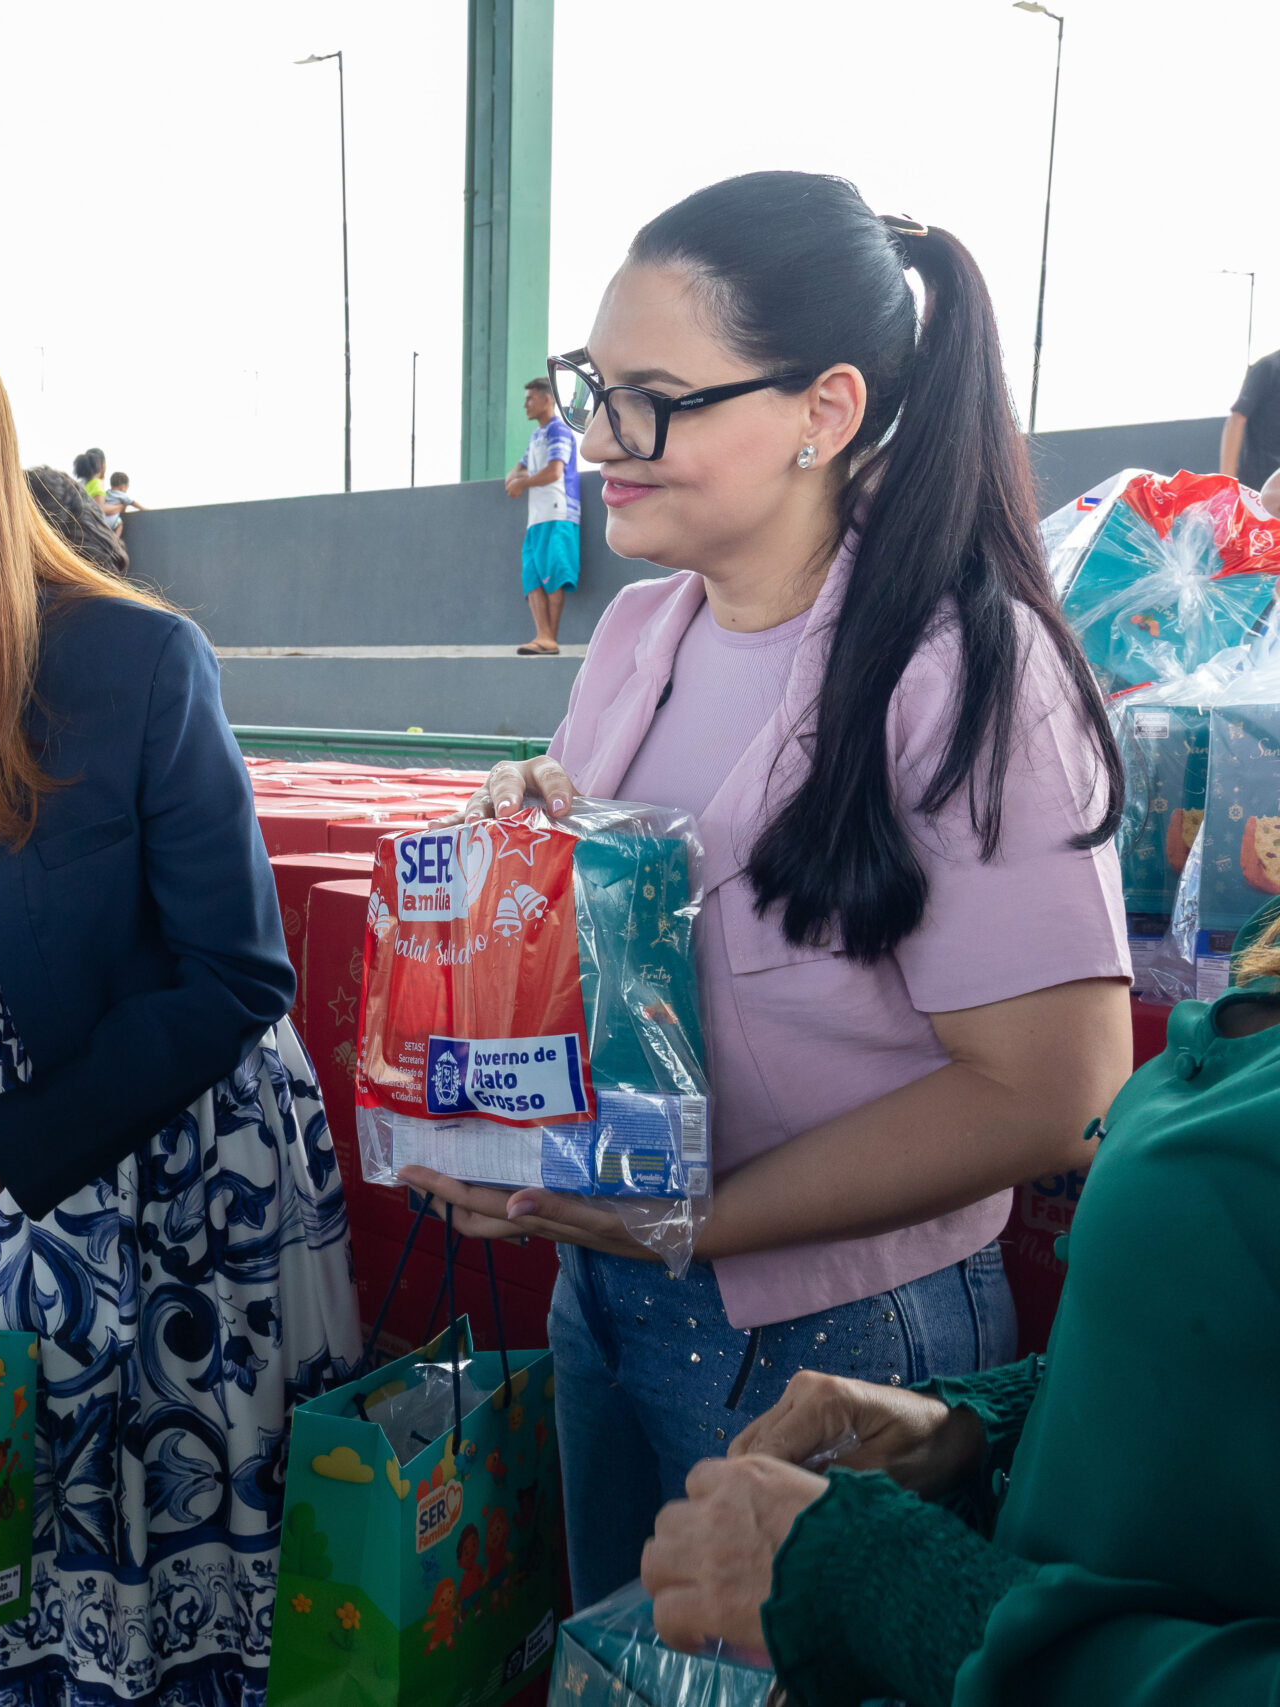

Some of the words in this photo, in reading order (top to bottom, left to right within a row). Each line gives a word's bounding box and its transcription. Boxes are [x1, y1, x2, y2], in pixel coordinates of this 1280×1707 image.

[400, 836, 453, 884] SER
[640, 963, 672, 985] Frutas
[404, 1041, 425, 1052] SETASC
[534, 1047, 557, 1063] de
[398, 1053, 424, 1065] Secretaria
[471, 1068, 518, 1090] Mato
[395, 1091, 423, 1104] Cidadania
[474, 1090, 546, 1112] Grosso
[419, 1499, 447, 1535] SER
